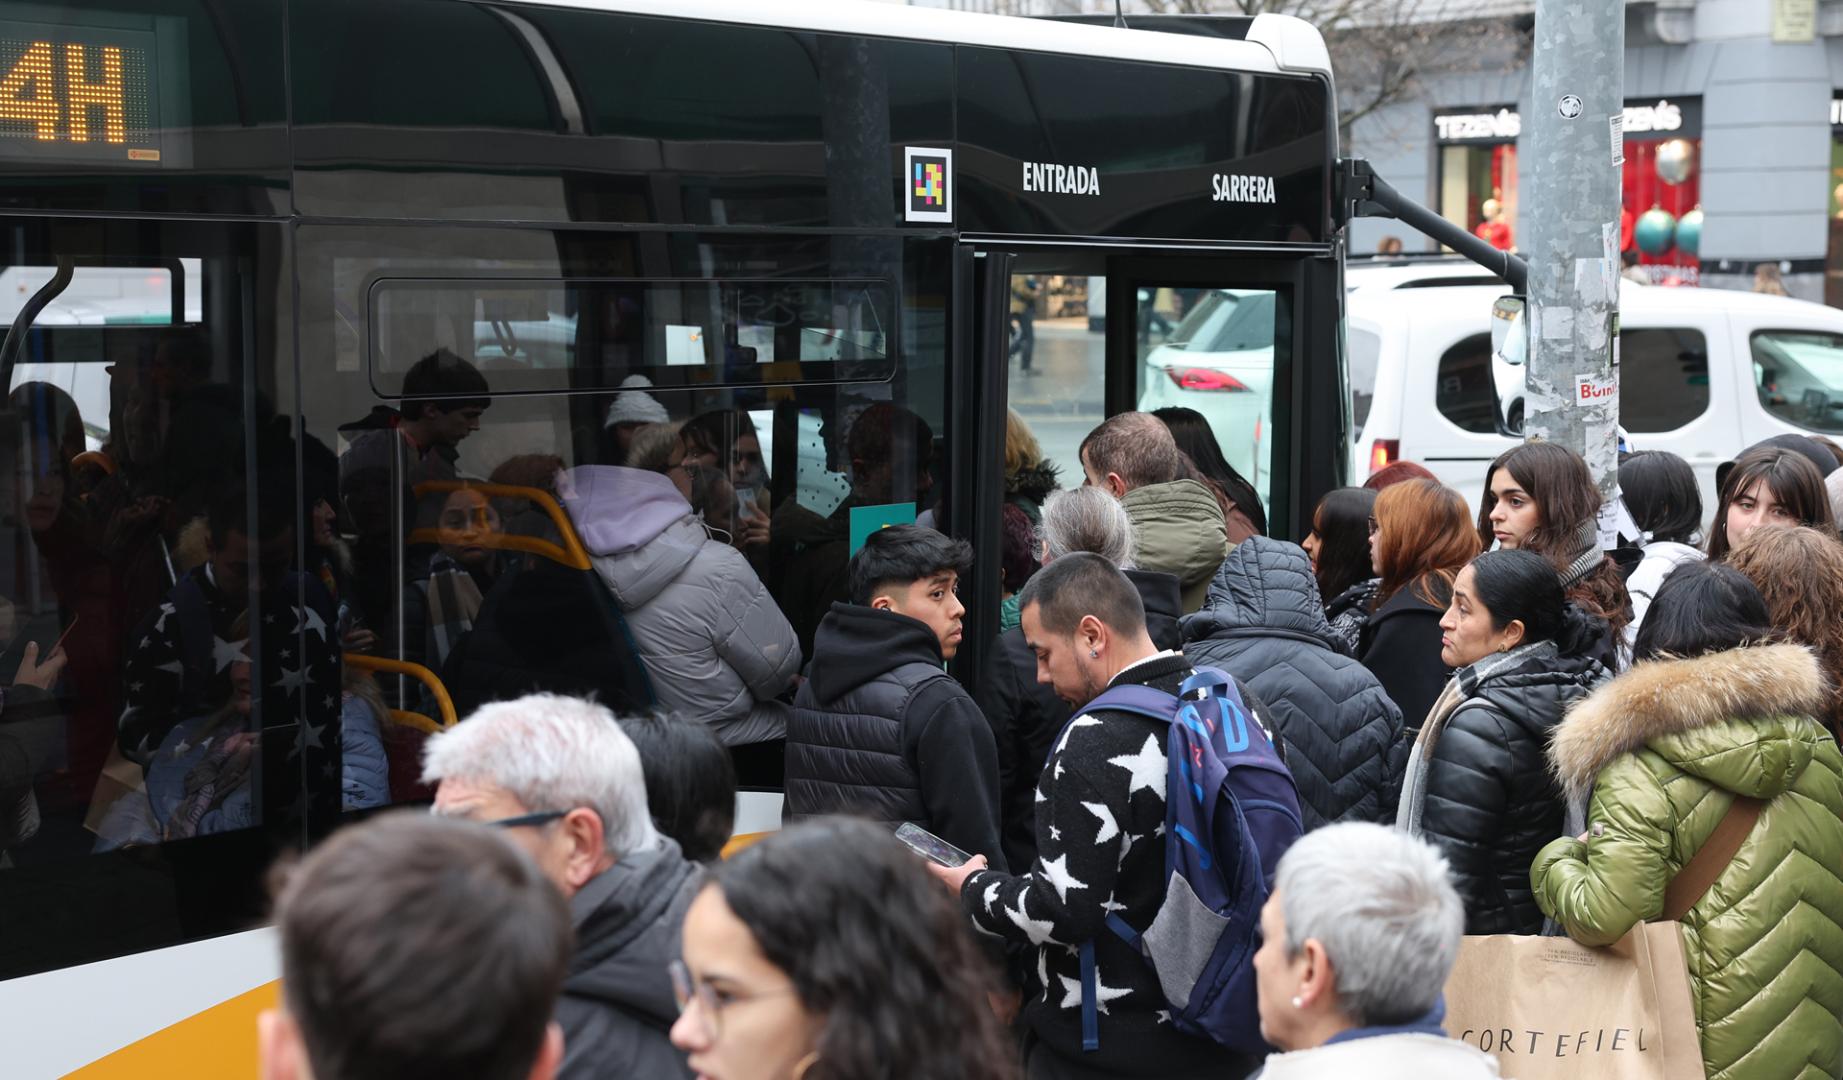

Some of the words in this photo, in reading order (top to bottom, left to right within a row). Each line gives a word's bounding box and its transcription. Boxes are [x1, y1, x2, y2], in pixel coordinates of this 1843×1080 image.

[0, 42, 125, 143] 4H
[1434, 108, 1521, 139] TEZENIS
[1621, 100, 1682, 132] ZENIS
[1022, 161, 1100, 196] ENTRADA
[1212, 173, 1276, 203] SARRERA
[1461, 1028, 1648, 1057] CORTEFIEL
